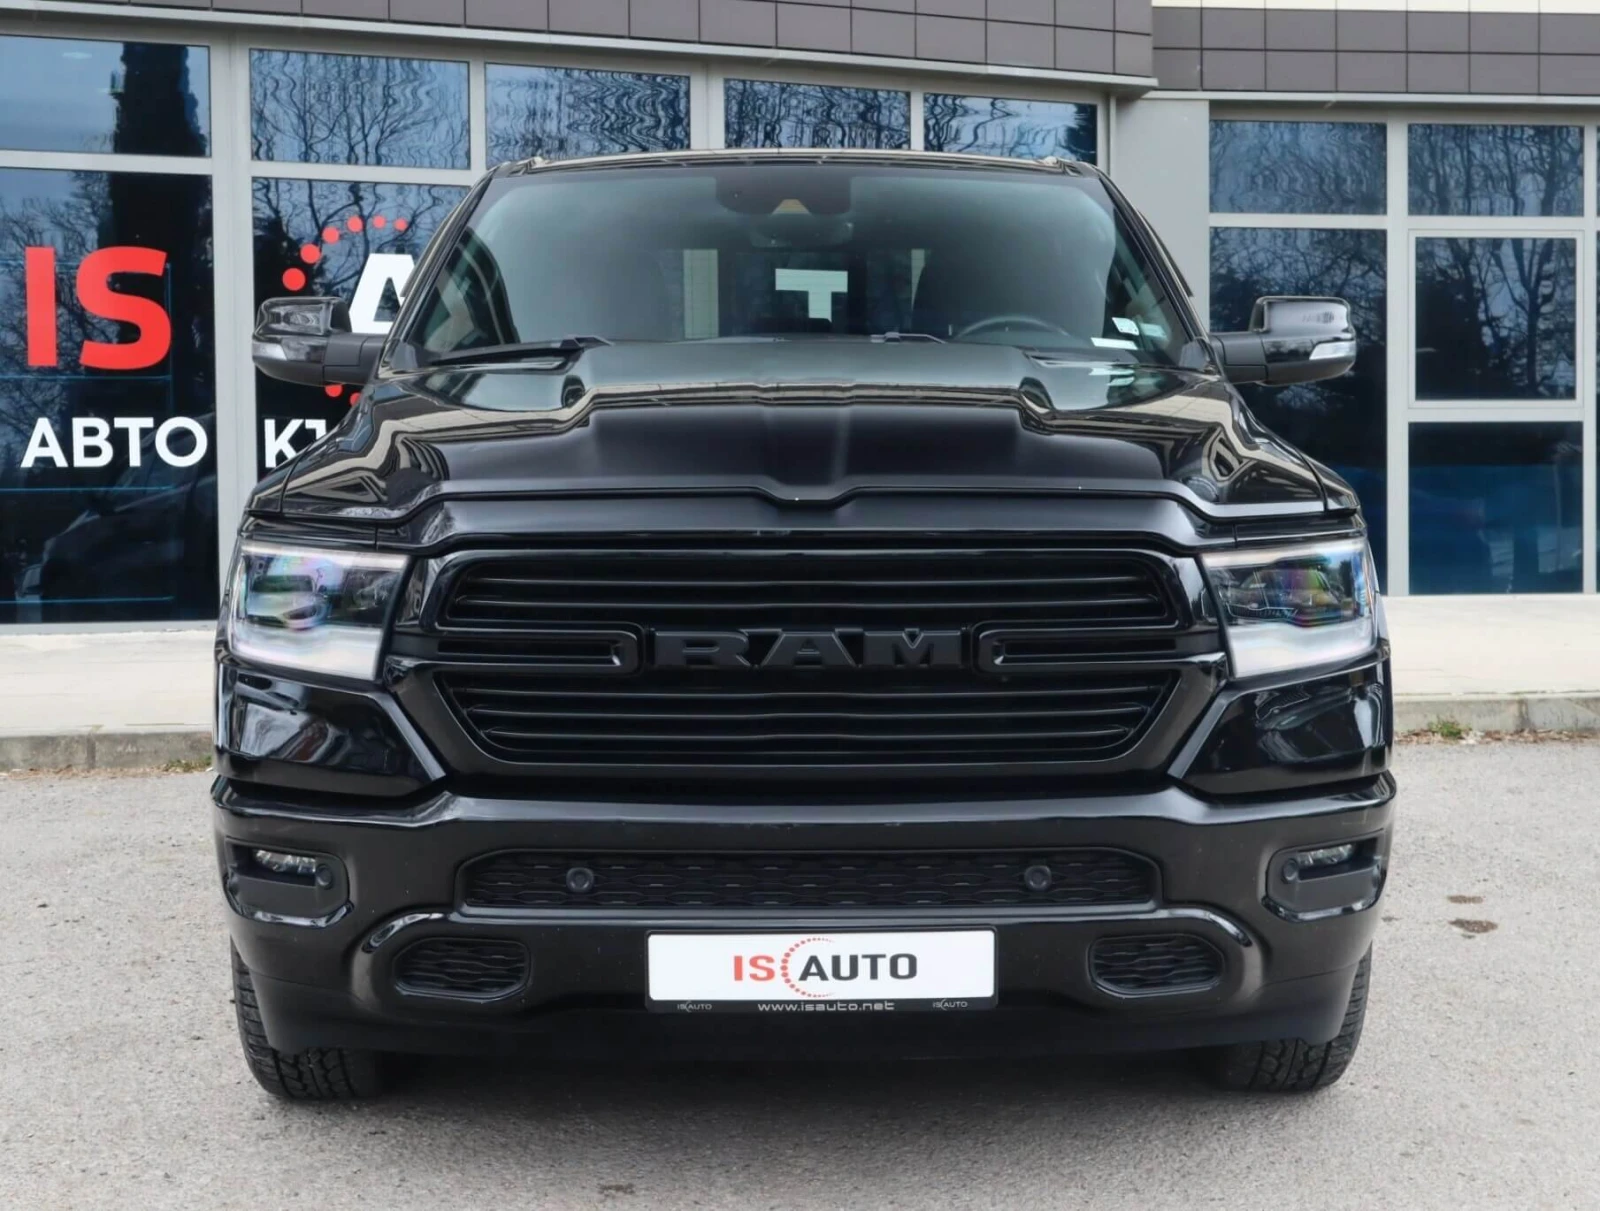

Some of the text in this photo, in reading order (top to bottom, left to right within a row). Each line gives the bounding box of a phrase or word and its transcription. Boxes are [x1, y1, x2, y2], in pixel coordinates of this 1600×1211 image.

[25, 246, 171, 370] IS
[654, 629, 962, 667] RAM
[757, 1001, 895, 1012] www.isauto.net
